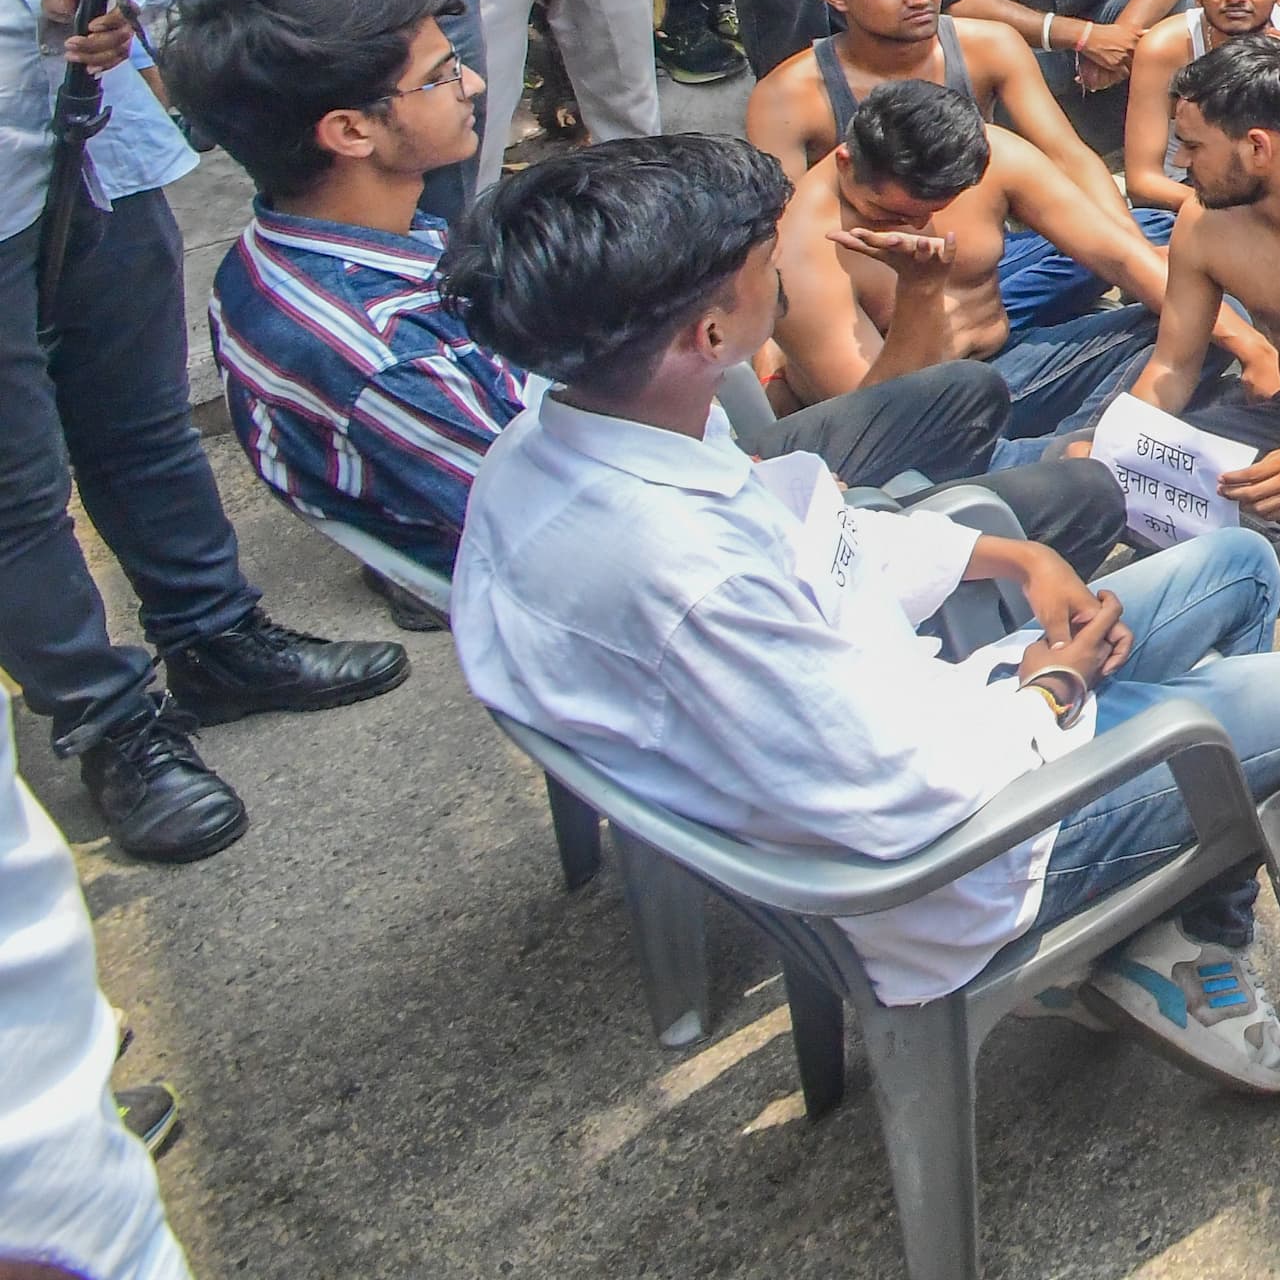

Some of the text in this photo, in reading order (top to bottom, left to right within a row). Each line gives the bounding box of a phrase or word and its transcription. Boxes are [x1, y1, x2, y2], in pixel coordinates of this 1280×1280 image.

[1136, 432, 1196, 475] छात्रसंघ
[1116, 464, 1210, 520] चुनाव बहाल
[1143, 514, 1178, 542] करो
